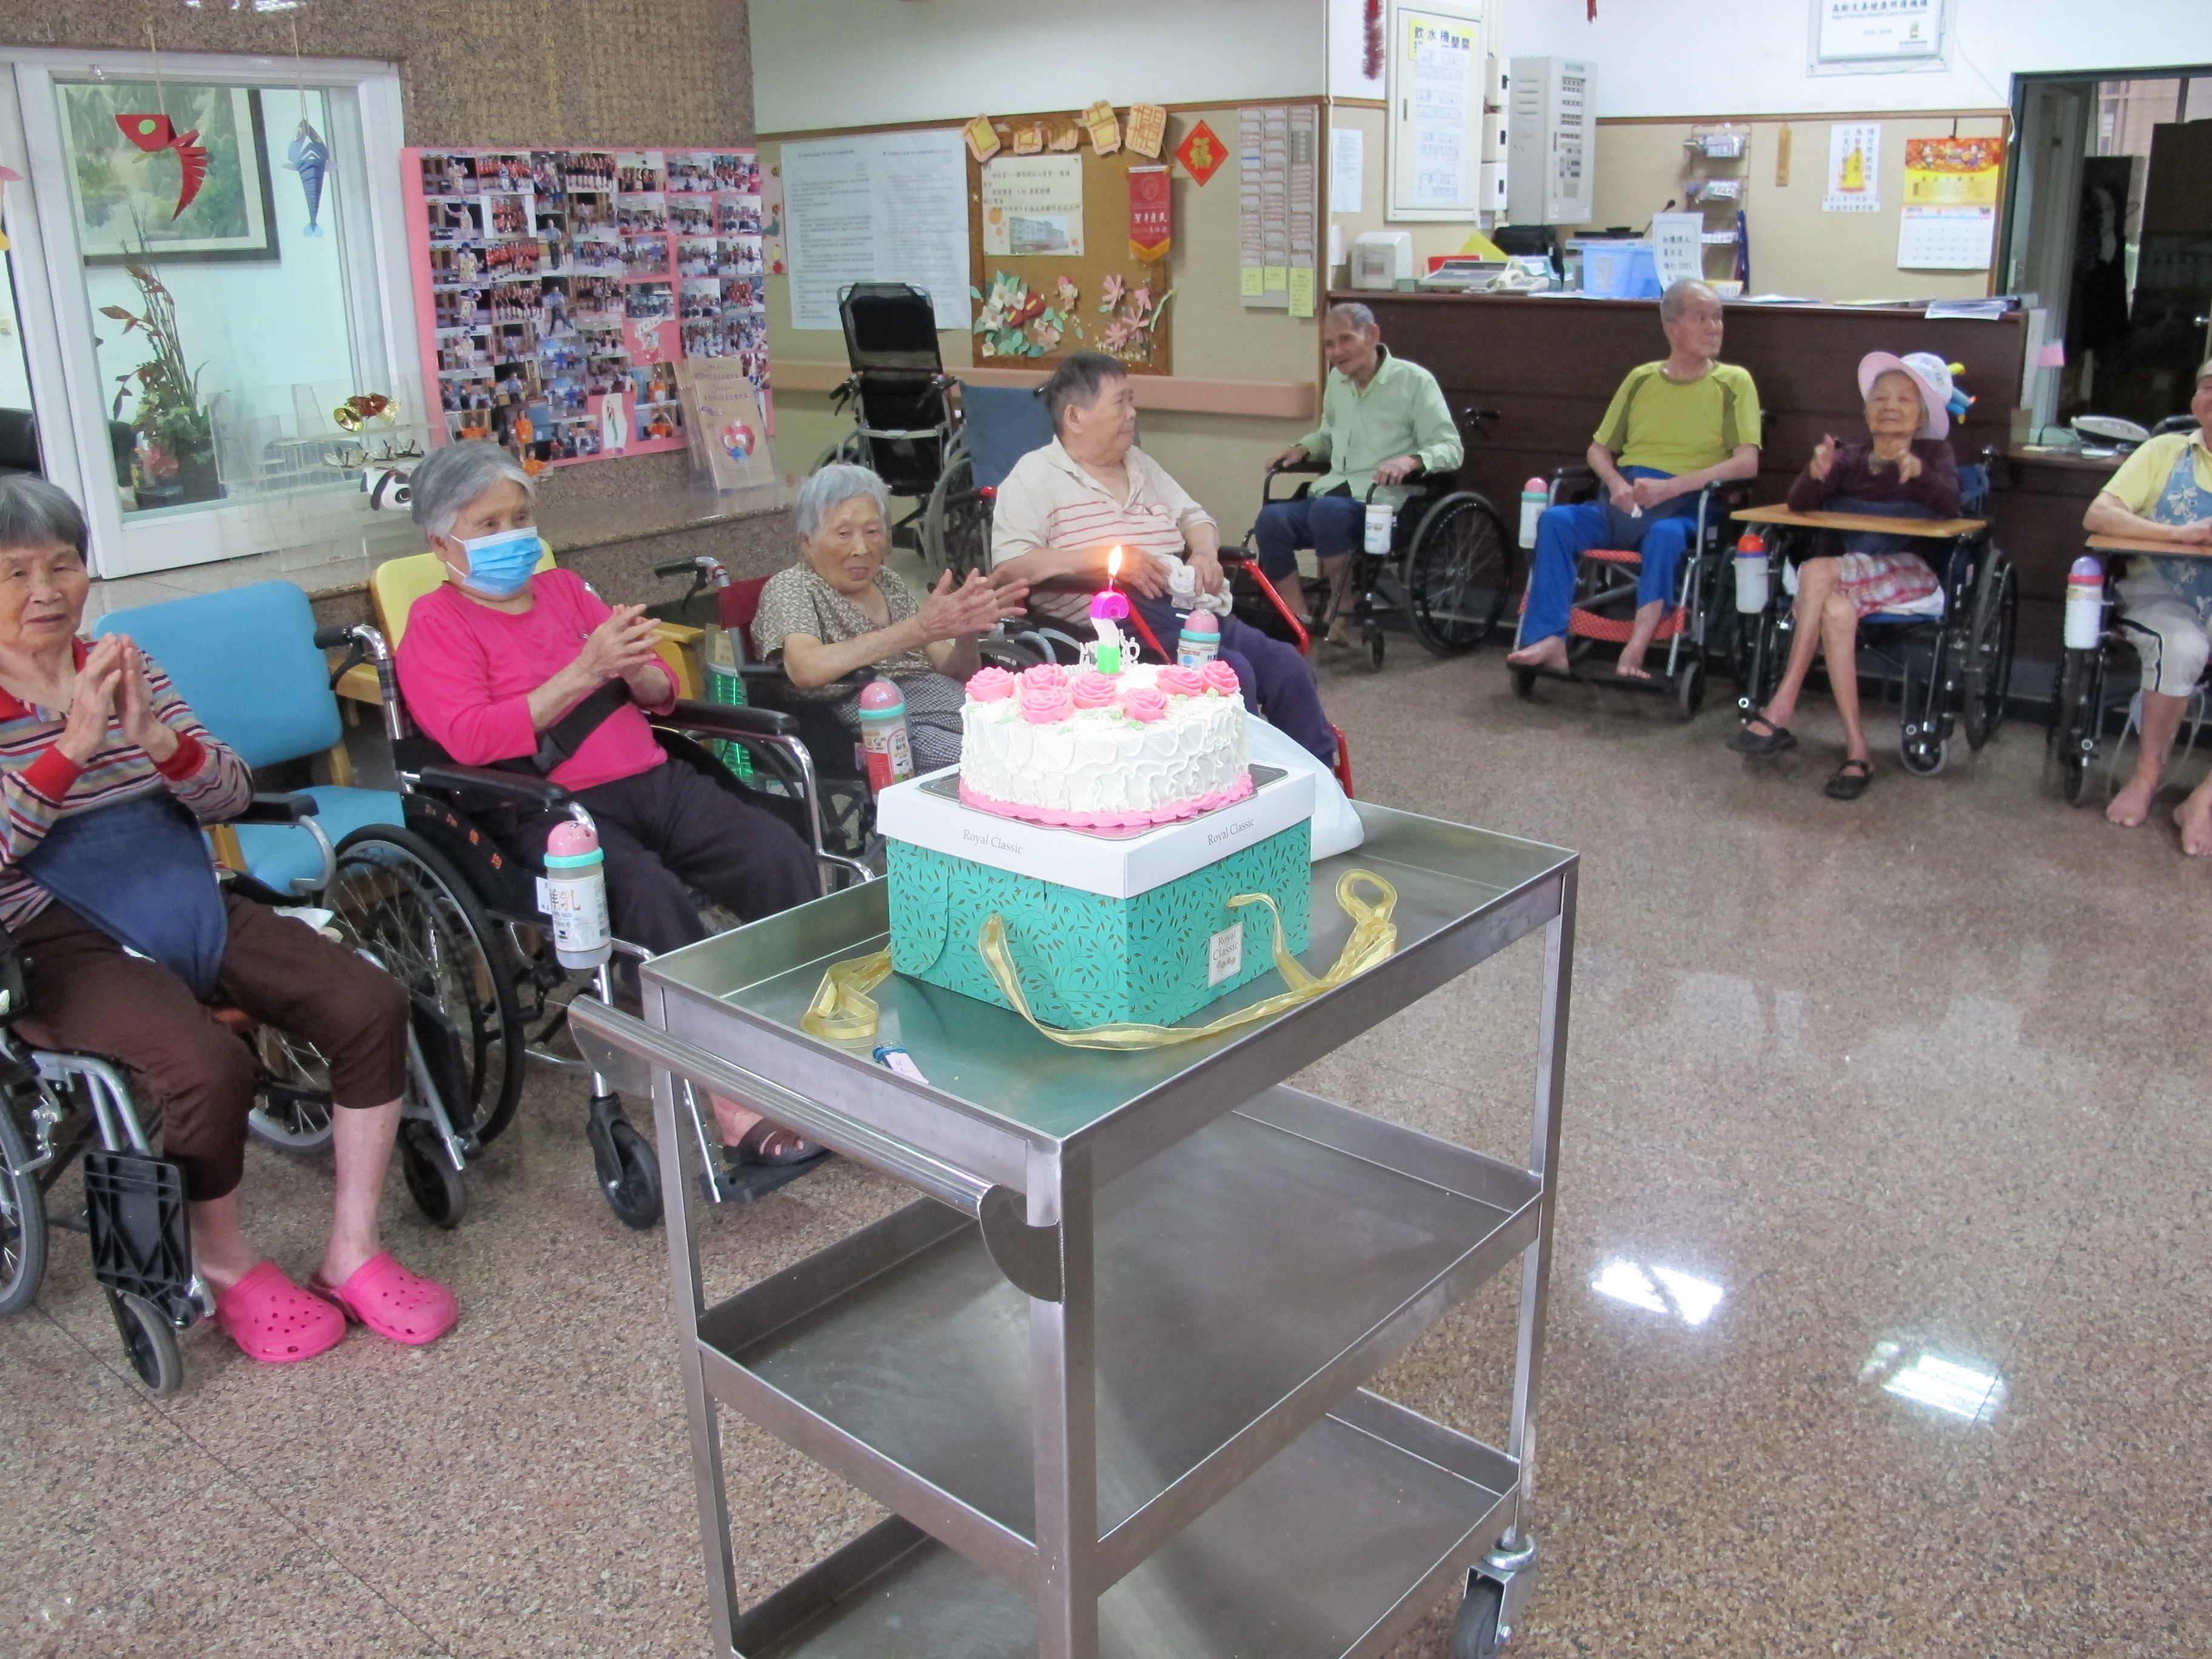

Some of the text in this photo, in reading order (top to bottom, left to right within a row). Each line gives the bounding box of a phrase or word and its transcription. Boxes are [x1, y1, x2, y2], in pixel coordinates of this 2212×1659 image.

[1190, 137, 1213, 170] 福
[963, 828, 1024, 854] Royal Classic
[1207, 817, 1255, 846] Royal Classic
[1212, 940, 1240, 961] Classic
[1218, 930, 1237, 947] Royal
